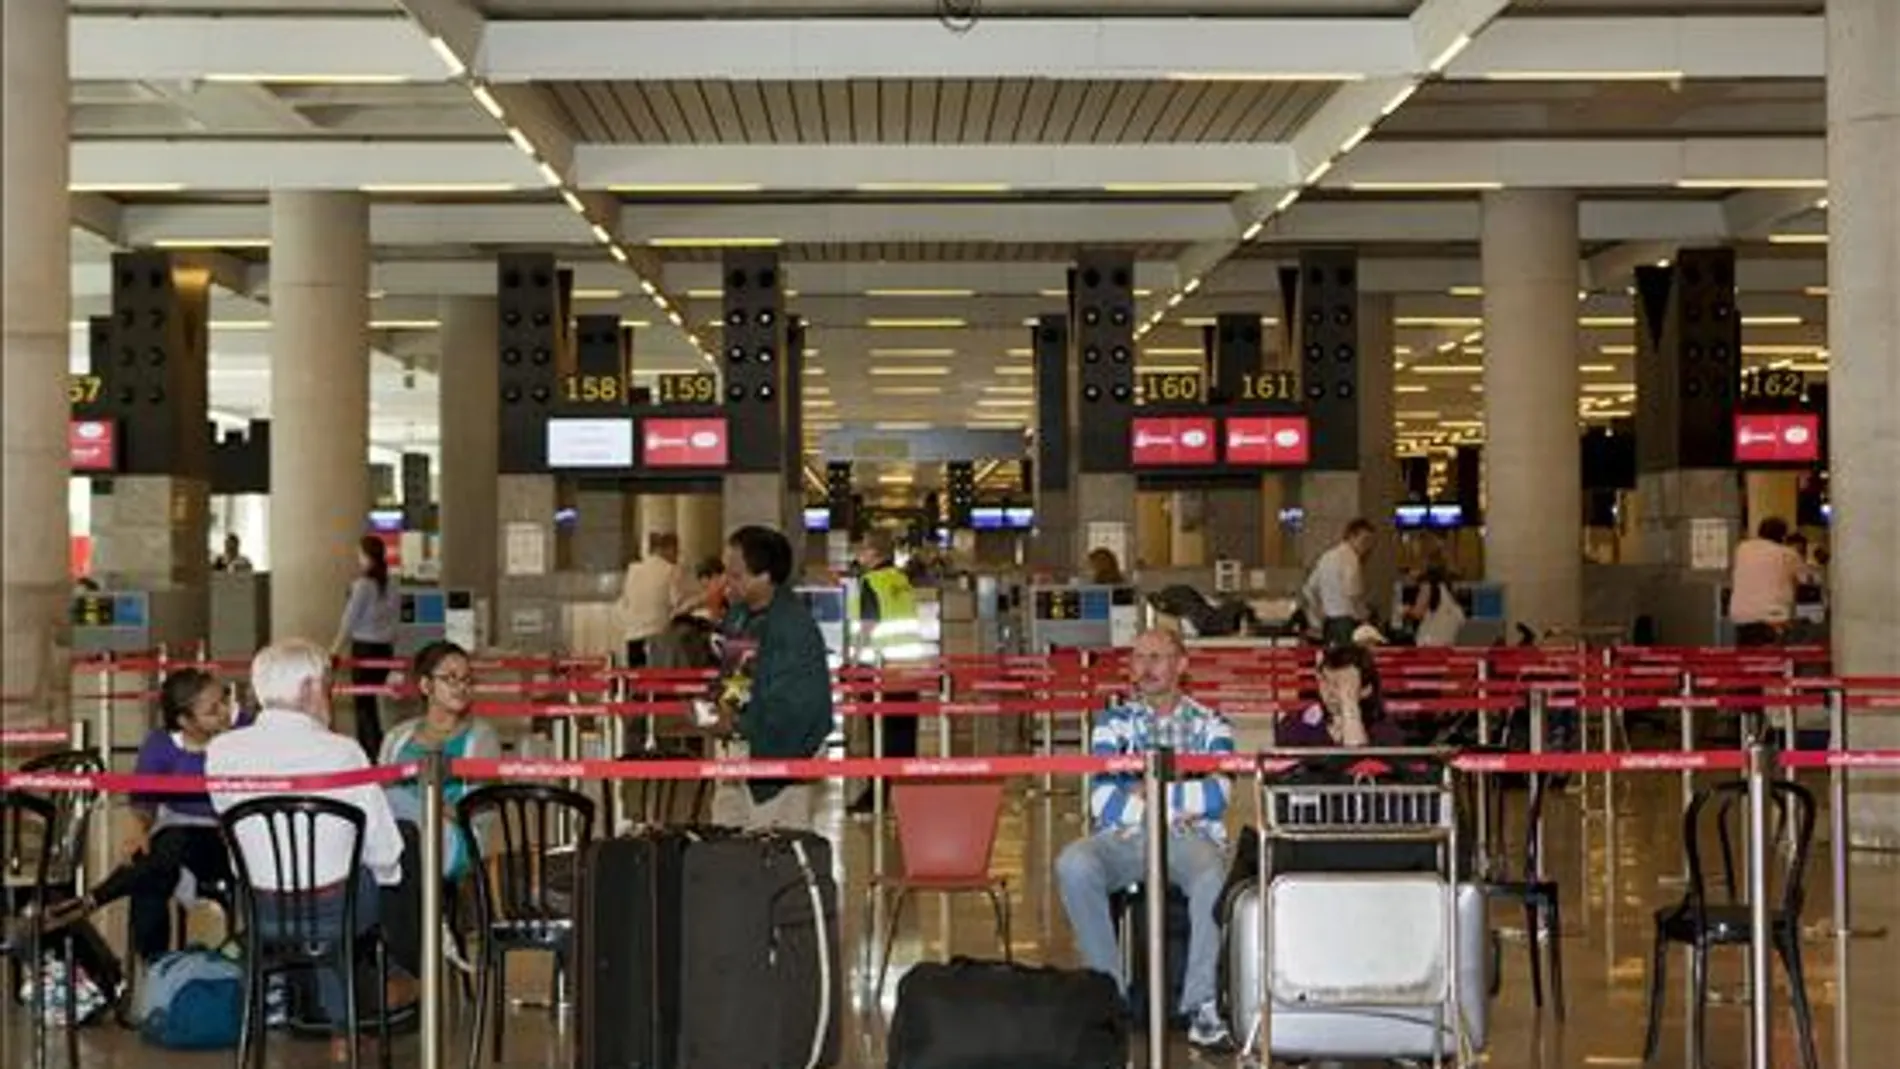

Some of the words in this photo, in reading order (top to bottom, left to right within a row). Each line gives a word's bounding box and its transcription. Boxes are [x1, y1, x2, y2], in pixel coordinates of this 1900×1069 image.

[566, 376, 617, 400] 158
[662, 376, 713, 400] 159
[1147, 376, 1198, 400] 160
[1242, 375, 1294, 399] 161
[1749, 373, 1801, 397] 162
